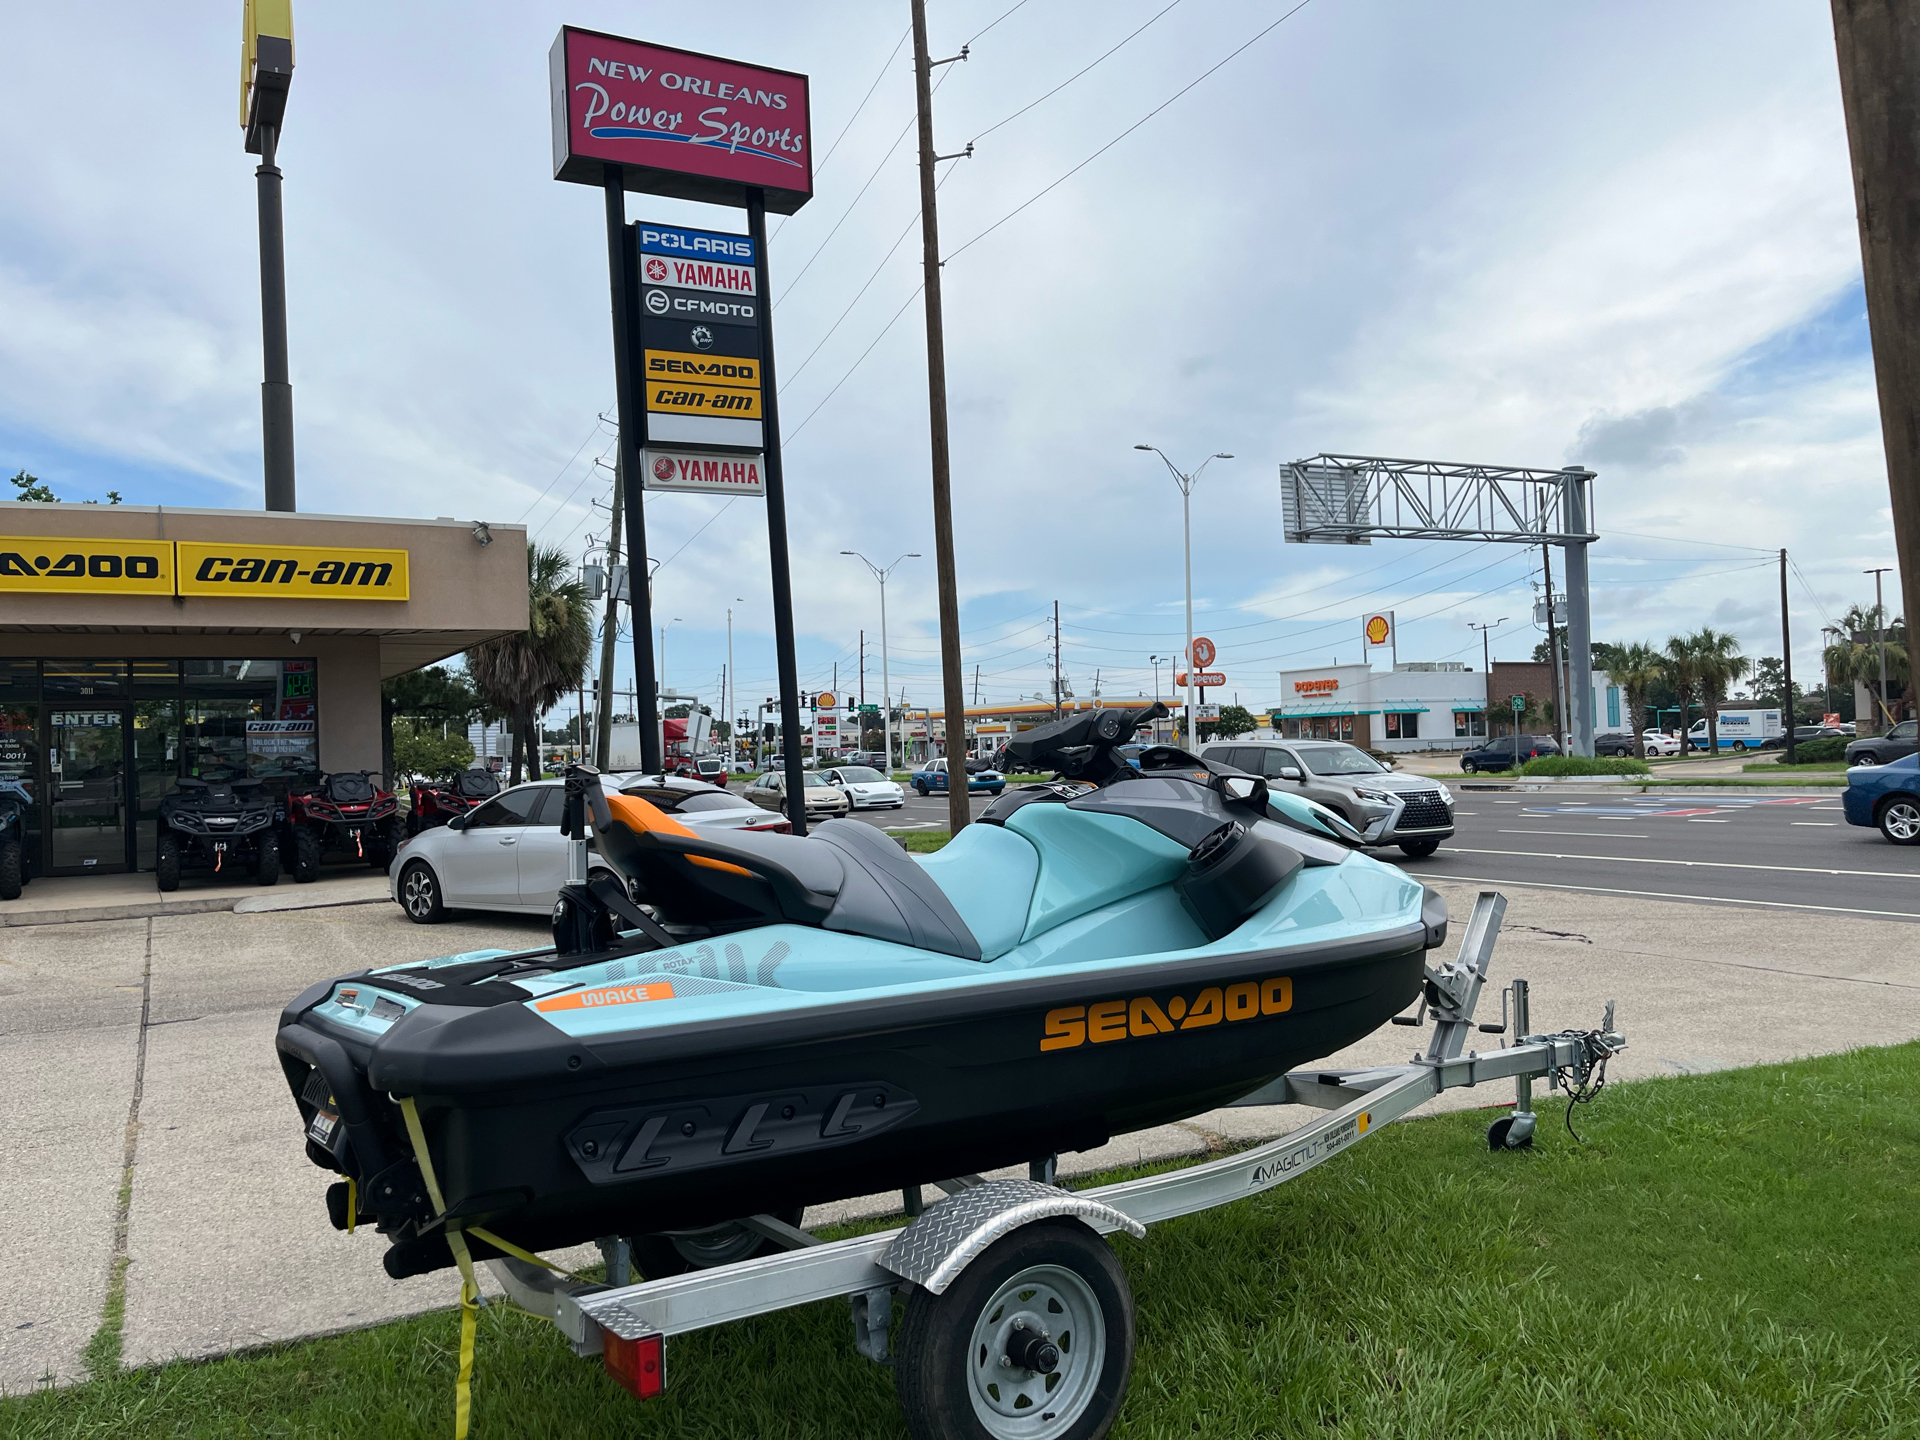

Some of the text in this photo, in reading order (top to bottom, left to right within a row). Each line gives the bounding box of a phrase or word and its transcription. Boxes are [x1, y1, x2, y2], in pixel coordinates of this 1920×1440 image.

[588, 57, 788, 110] NEW ORLEANS
[575, 82, 803, 155] Power Sports
[642, 230, 752, 257] POLARIS
[673, 261, 753, 292] YAMAHA
[674, 298, 754, 318] CFMOTO
[655, 390, 754, 411] can-am
[677, 459, 760, 485] YAMAHA
[195, 557, 393, 586] can-am
[80, 687, 94, 695] 3011
[50, 714, 121, 725] ENTER
[247, 722, 314, 732] can-am
[252, 738, 276, 746] UNLOCK
[277, 738, 288, 746] THE
[252, 745, 260, 753] OF
[262, 745, 278, 753] YOUR
[663, 956, 695, 970] ROTAX
[581, 987, 650, 1006] WAKE
[1261, 1141, 1319, 1181] MAGICTILT
